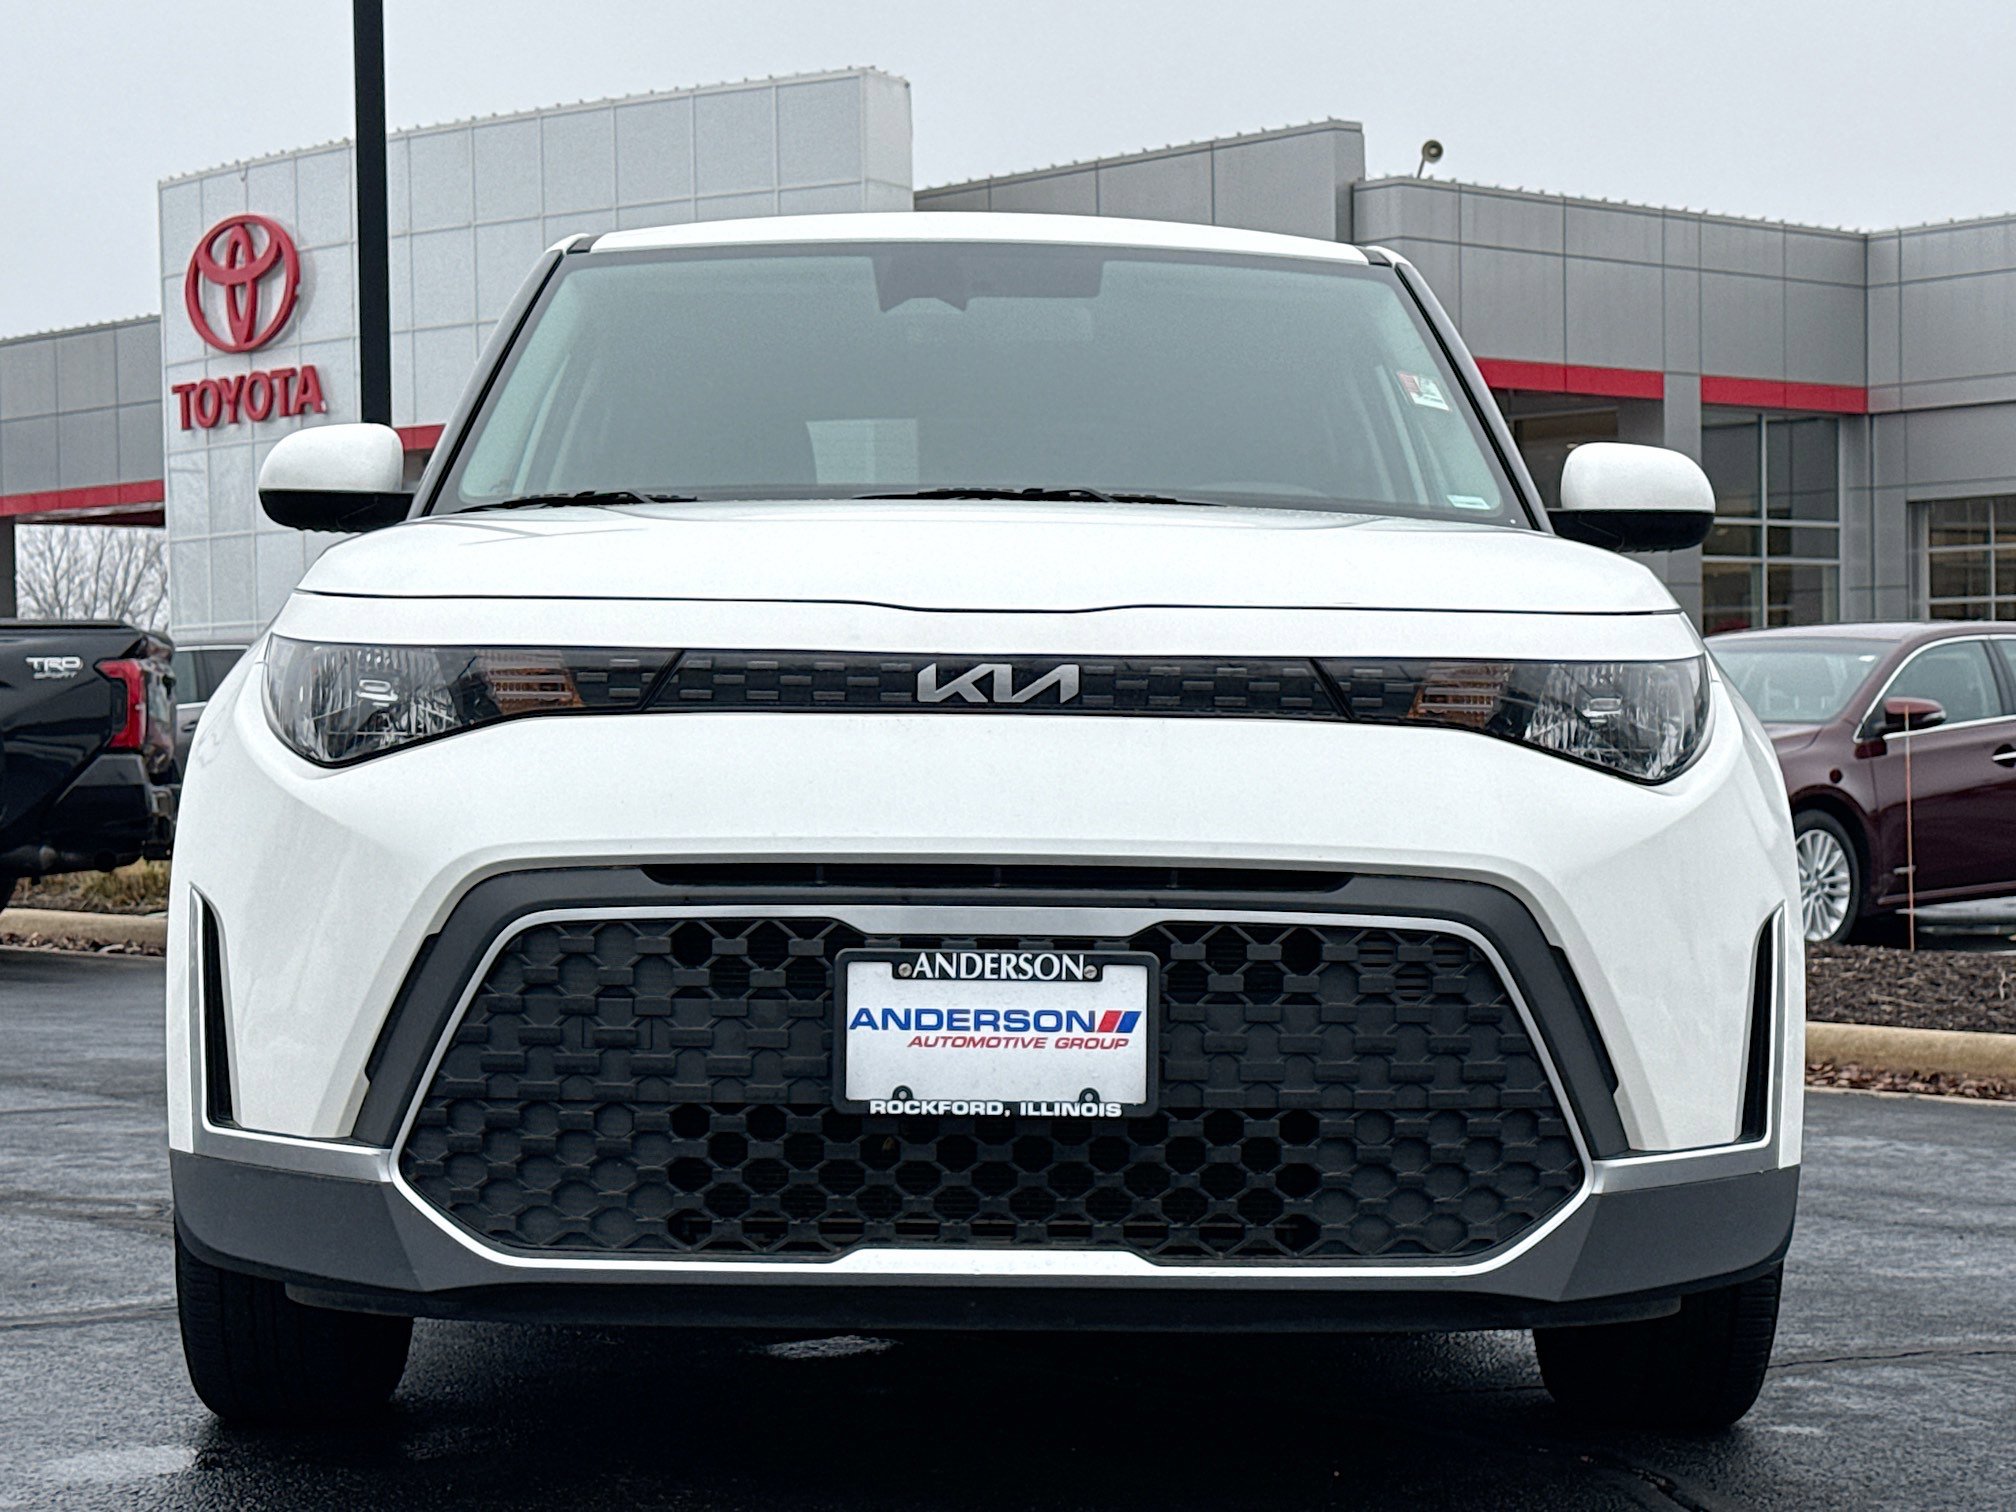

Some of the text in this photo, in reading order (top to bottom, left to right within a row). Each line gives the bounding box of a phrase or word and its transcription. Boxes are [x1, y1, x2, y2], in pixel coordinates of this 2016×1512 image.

[171, 365, 326, 430] TOYOTA
[25, 656, 84, 672] TRD
[917, 663, 1080, 704] KIA
[912, 952, 1085, 981] ANDERSON
[849, 1007, 1096, 1033] ANDERSON
[907, 1035, 1129, 1050] AUTOMOTIVE GROUP
[869, 1100, 1122, 1118] ROCKFORD, ILLINOIS
